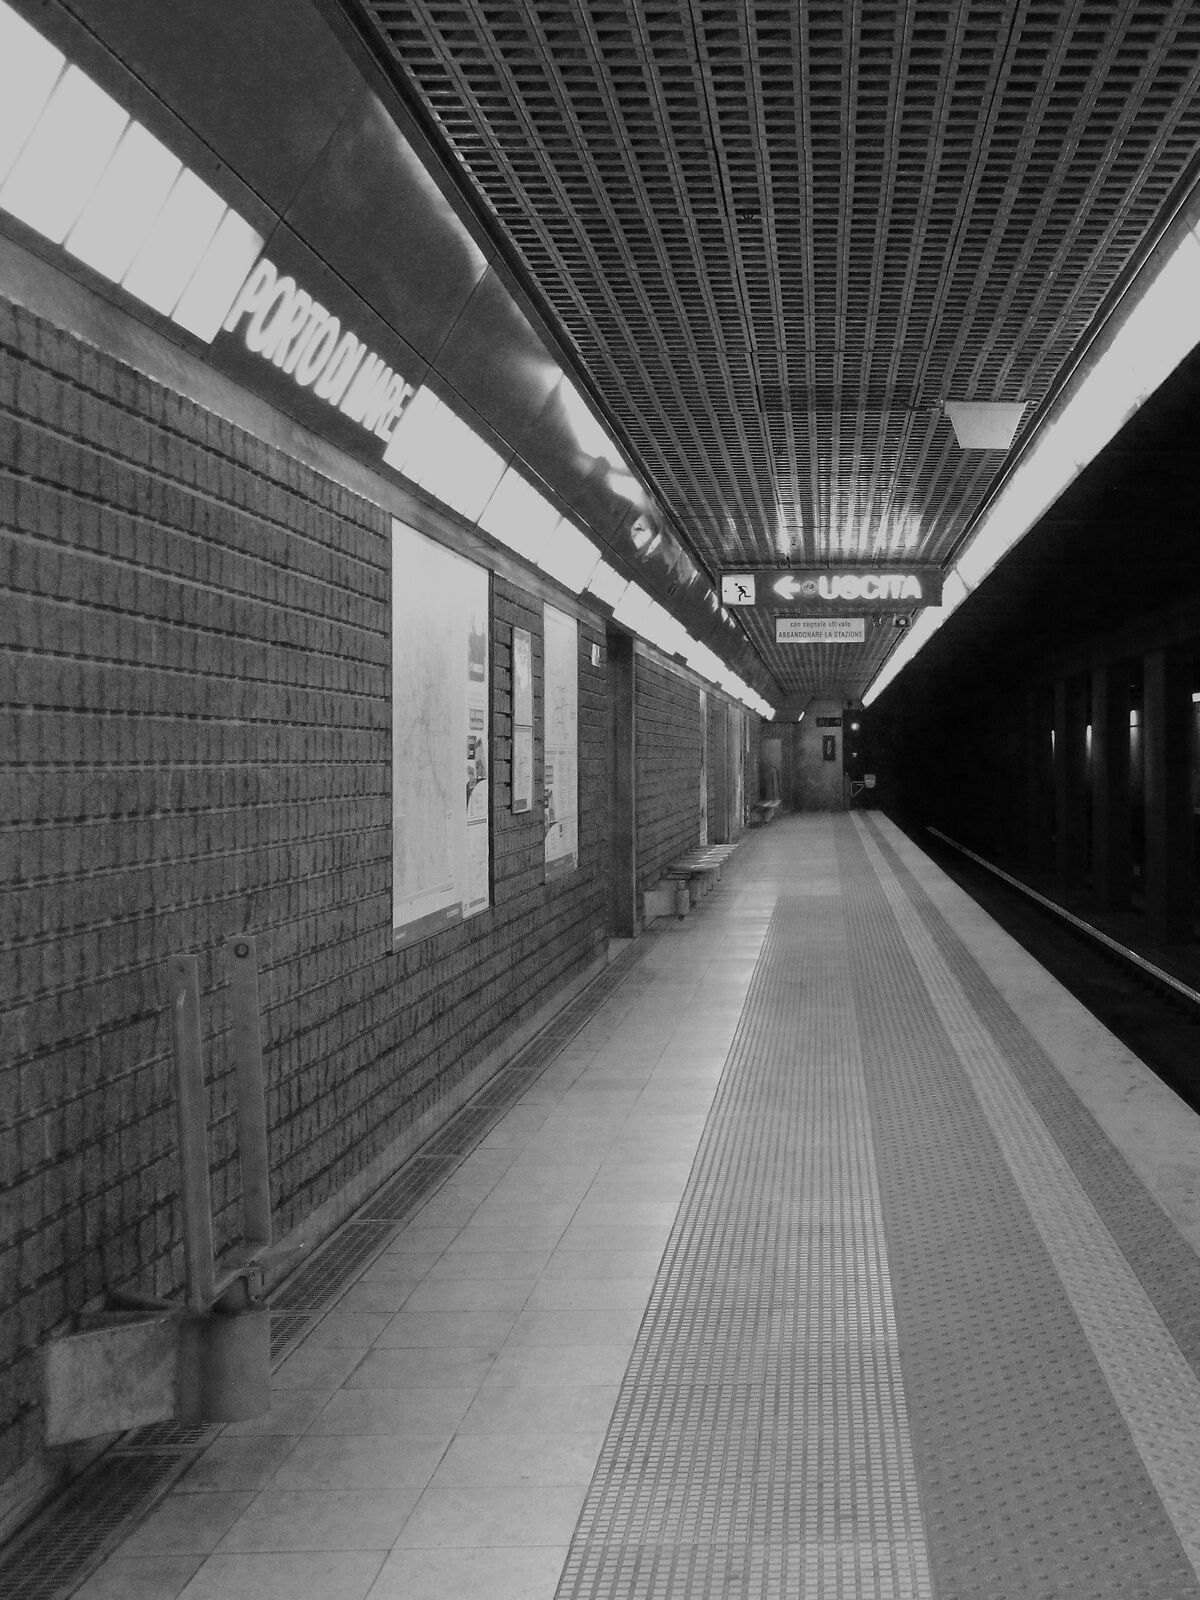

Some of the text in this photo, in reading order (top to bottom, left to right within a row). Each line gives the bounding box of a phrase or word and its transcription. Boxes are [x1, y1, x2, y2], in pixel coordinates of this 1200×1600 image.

[223, 257, 414, 443] PORTO DI MARE
[818, 574, 922, 599] USCITA
[803, 621, 826, 629] segnale
[828, 620, 852, 628] attivato
